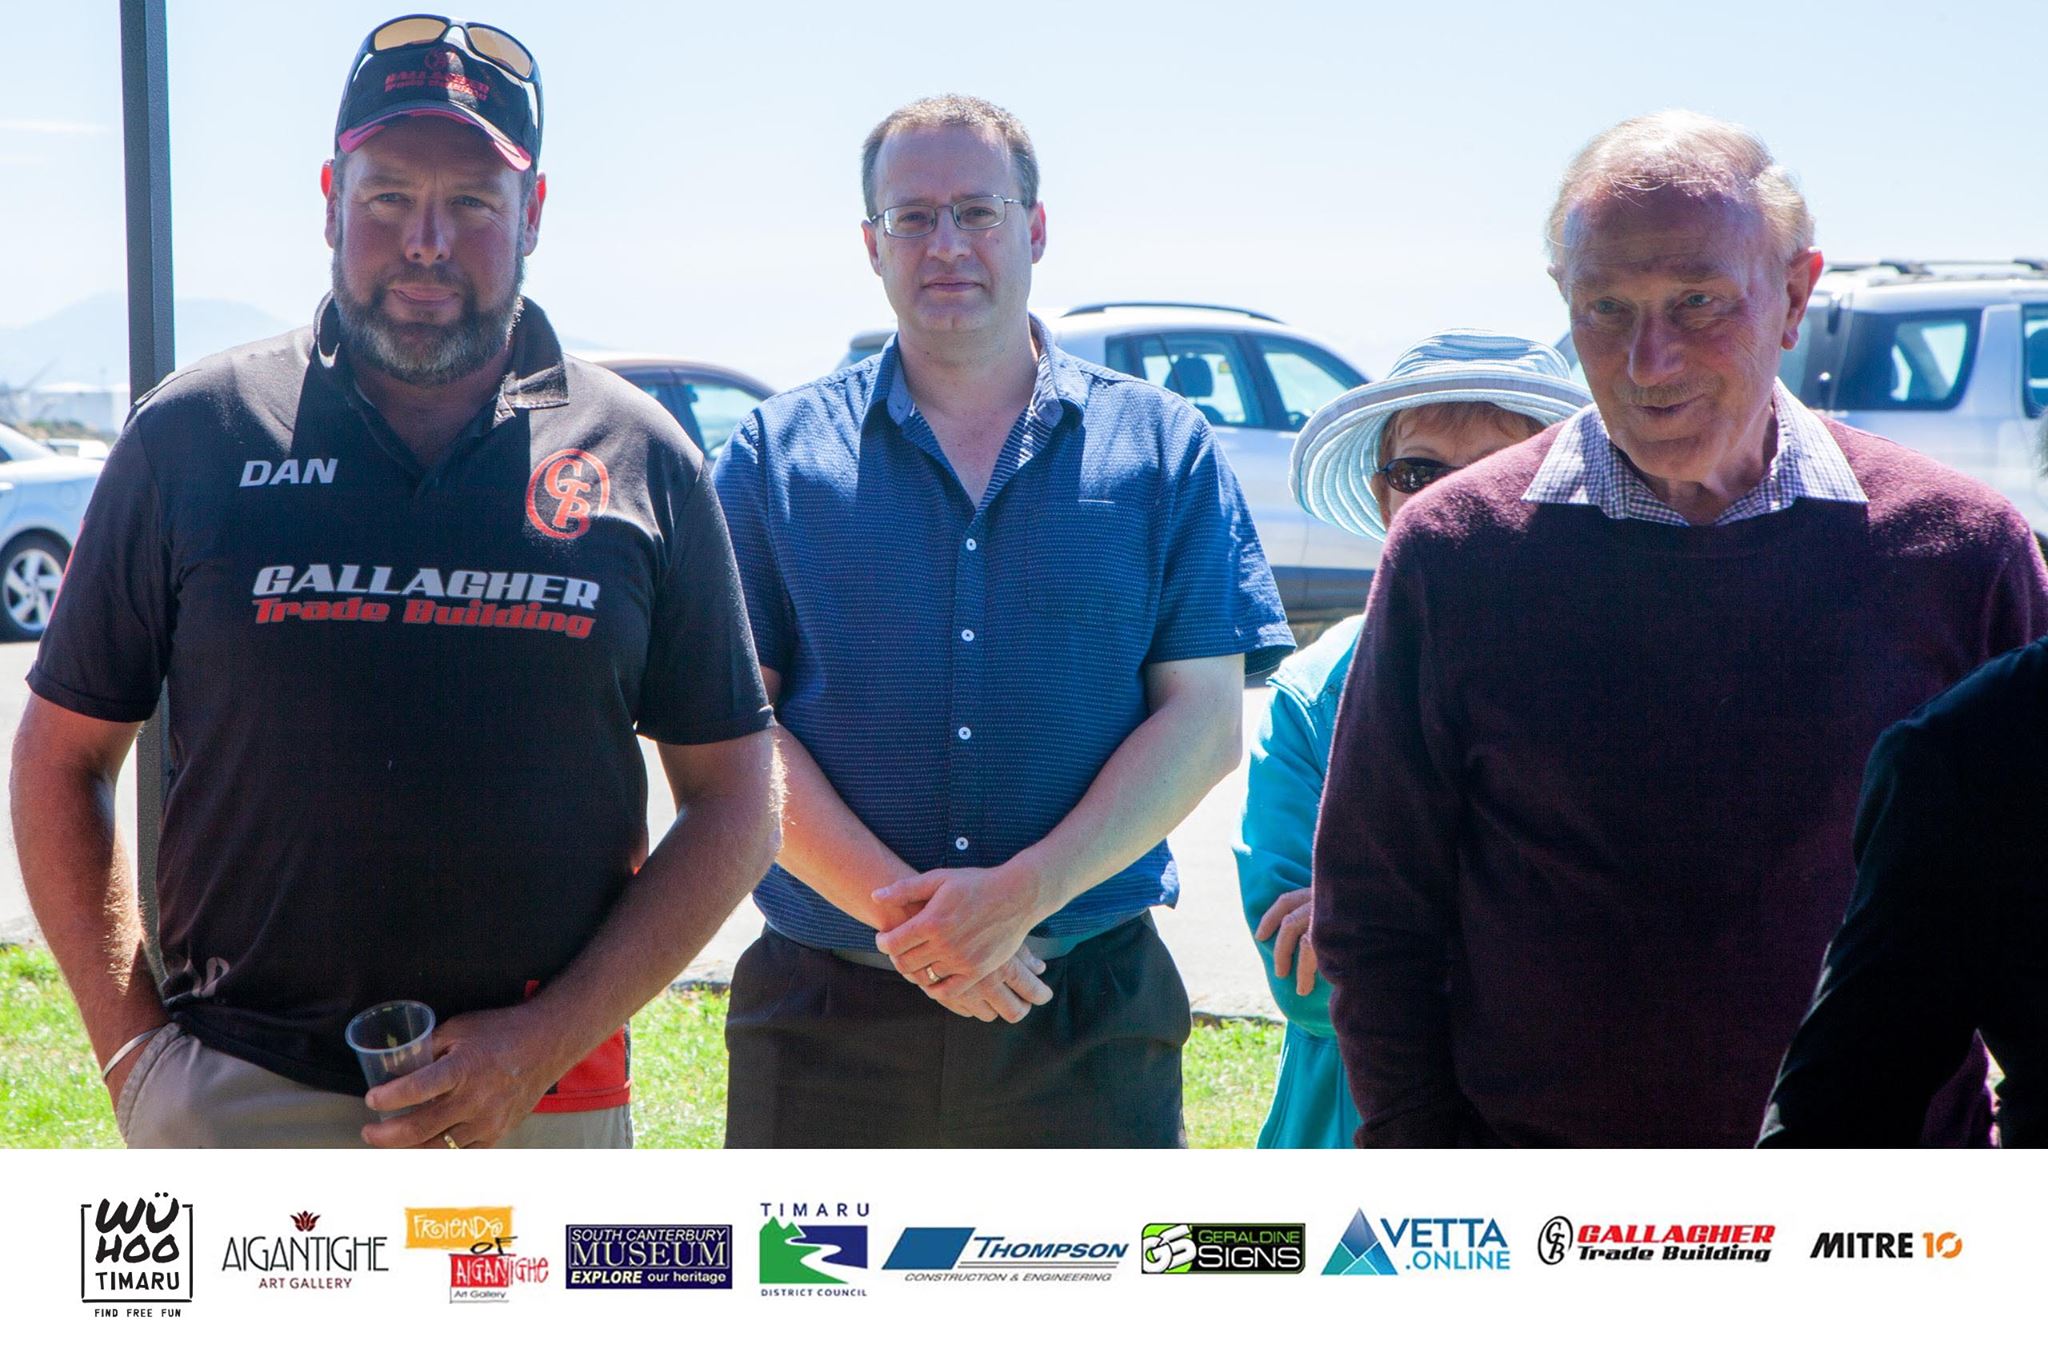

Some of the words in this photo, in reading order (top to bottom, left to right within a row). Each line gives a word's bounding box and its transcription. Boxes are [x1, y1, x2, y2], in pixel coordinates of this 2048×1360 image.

[239, 457, 338, 488] DAN
[252, 563, 601, 610] GALLAGHER
[252, 597, 390, 625] Trade
[402, 598, 596, 640] Building
